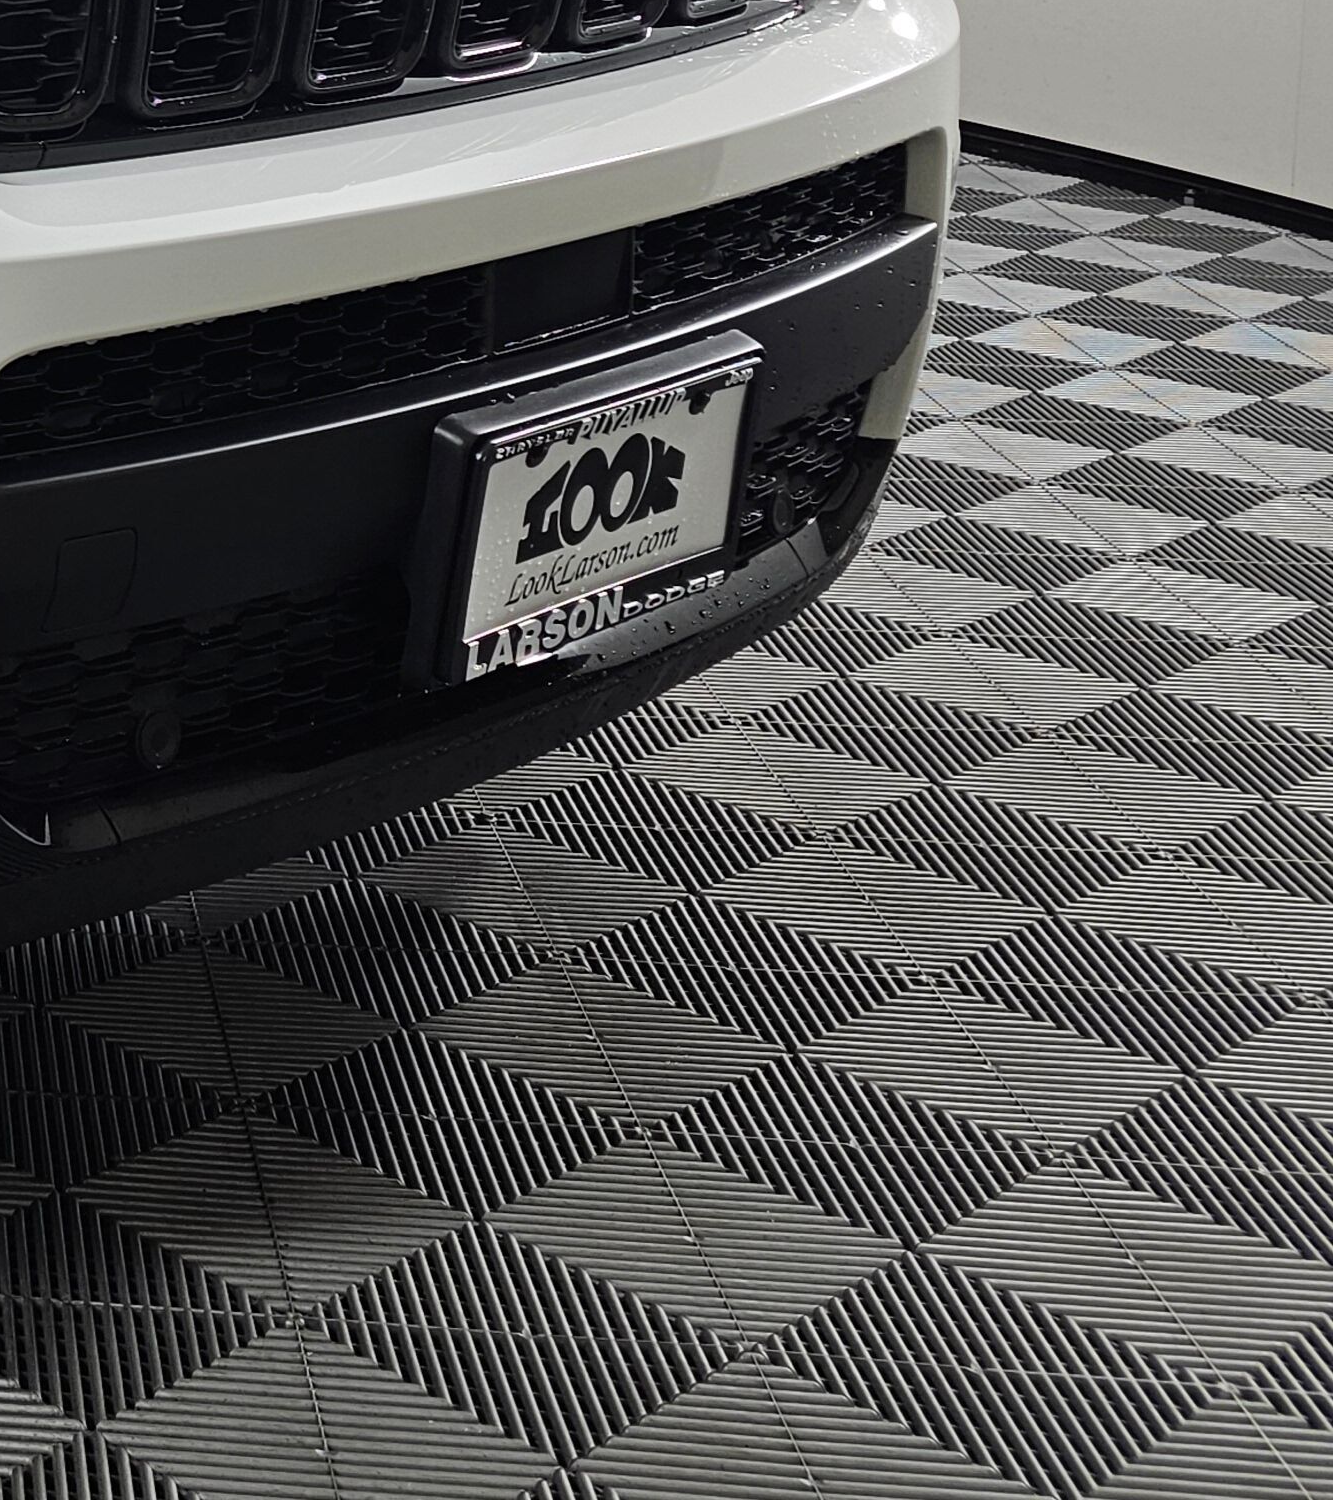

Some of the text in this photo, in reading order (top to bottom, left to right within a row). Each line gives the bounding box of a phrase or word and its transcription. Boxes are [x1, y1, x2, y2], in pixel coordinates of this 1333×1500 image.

[495, 425, 575, 460] CHRYSLER
[515, 432, 687, 565] LOOK
[504, 523, 680, 606] LookLarson.com
[465, 569, 726, 682] LARSON DODGE
